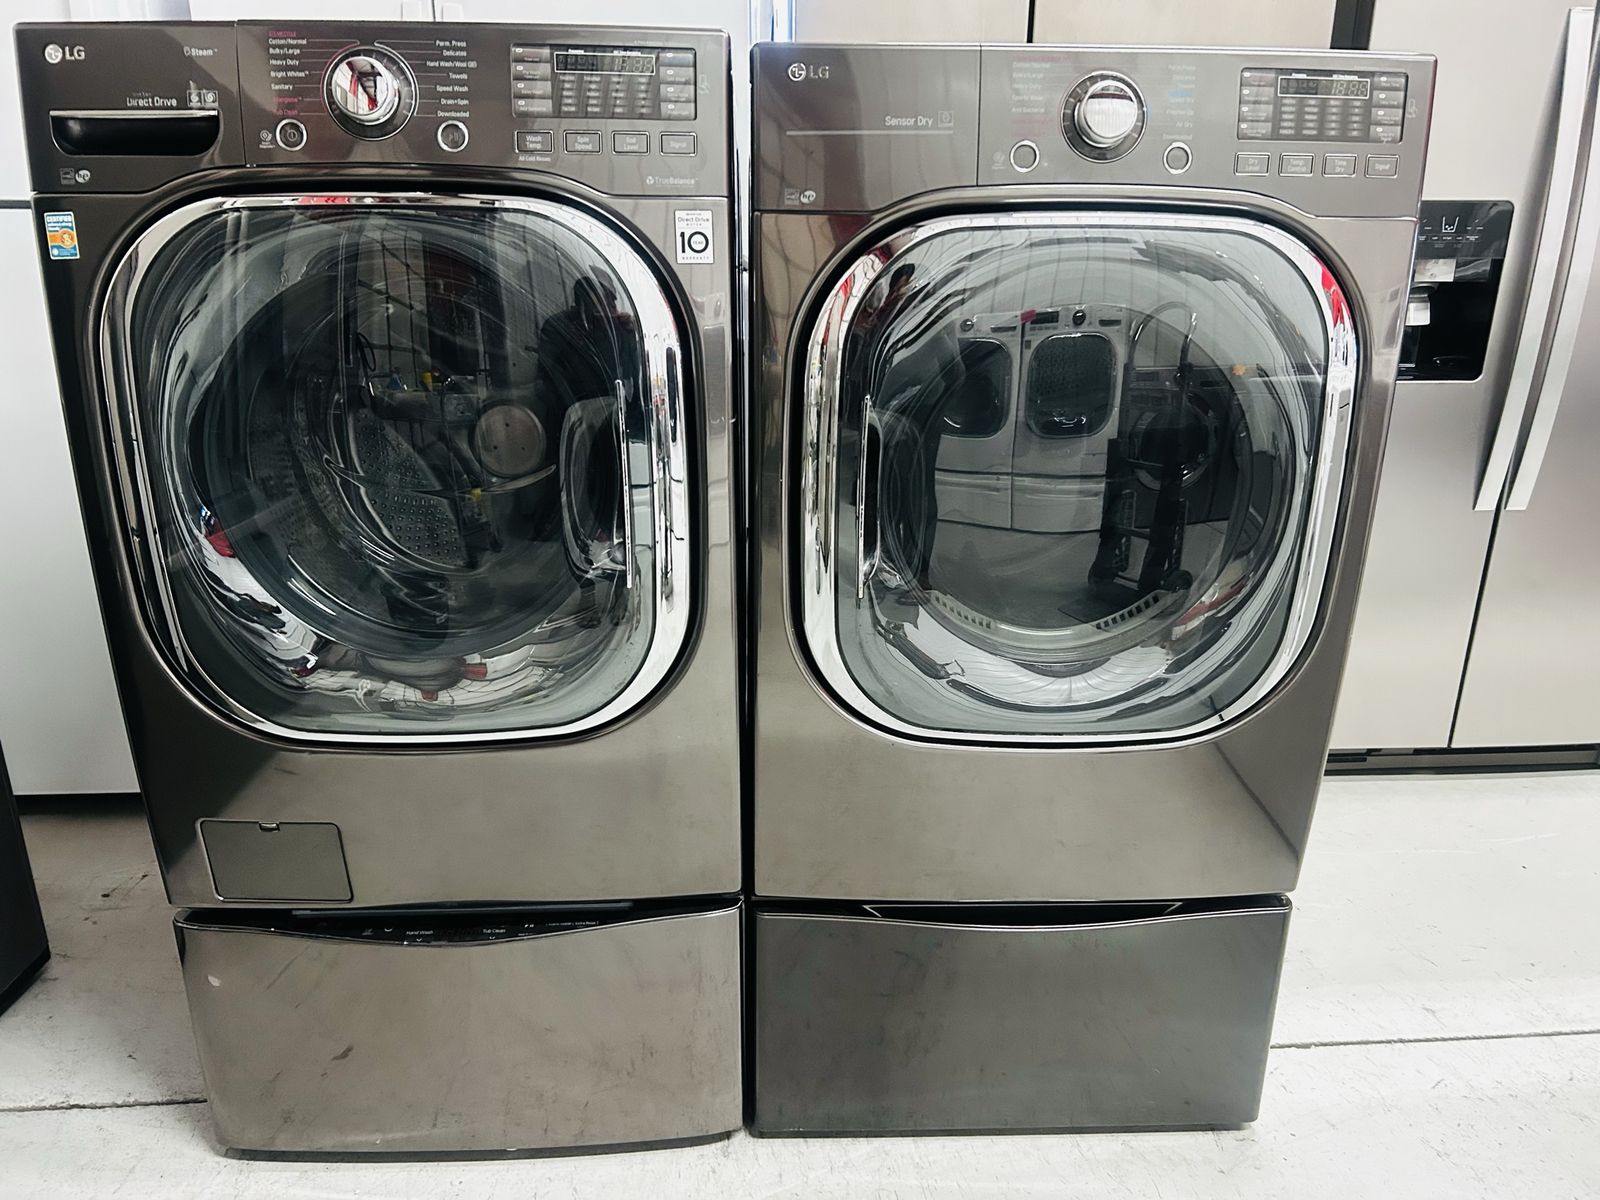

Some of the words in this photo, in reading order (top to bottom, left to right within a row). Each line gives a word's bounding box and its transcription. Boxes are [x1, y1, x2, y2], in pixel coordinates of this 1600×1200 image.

[65, 45, 85, 60] LG
[442, 49, 467, 57] Delicates
[809, 66, 829, 79] LG
[271, 83, 293, 91] Sanitary
[454, 84, 468, 92] Wash
[126, 96, 152, 107] Direct
[154, 96, 178, 107] Drive
[440, 98, 470, 106] Drain+Spin
[437, 110, 470, 118] Downloaded
[884, 116, 916, 127] Sensor
[918, 116, 933, 127] Dry
[574, 142, 592, 150] Speed
[670, 140, 686, 149] Signal
[680, 231, 710, 254] 10
